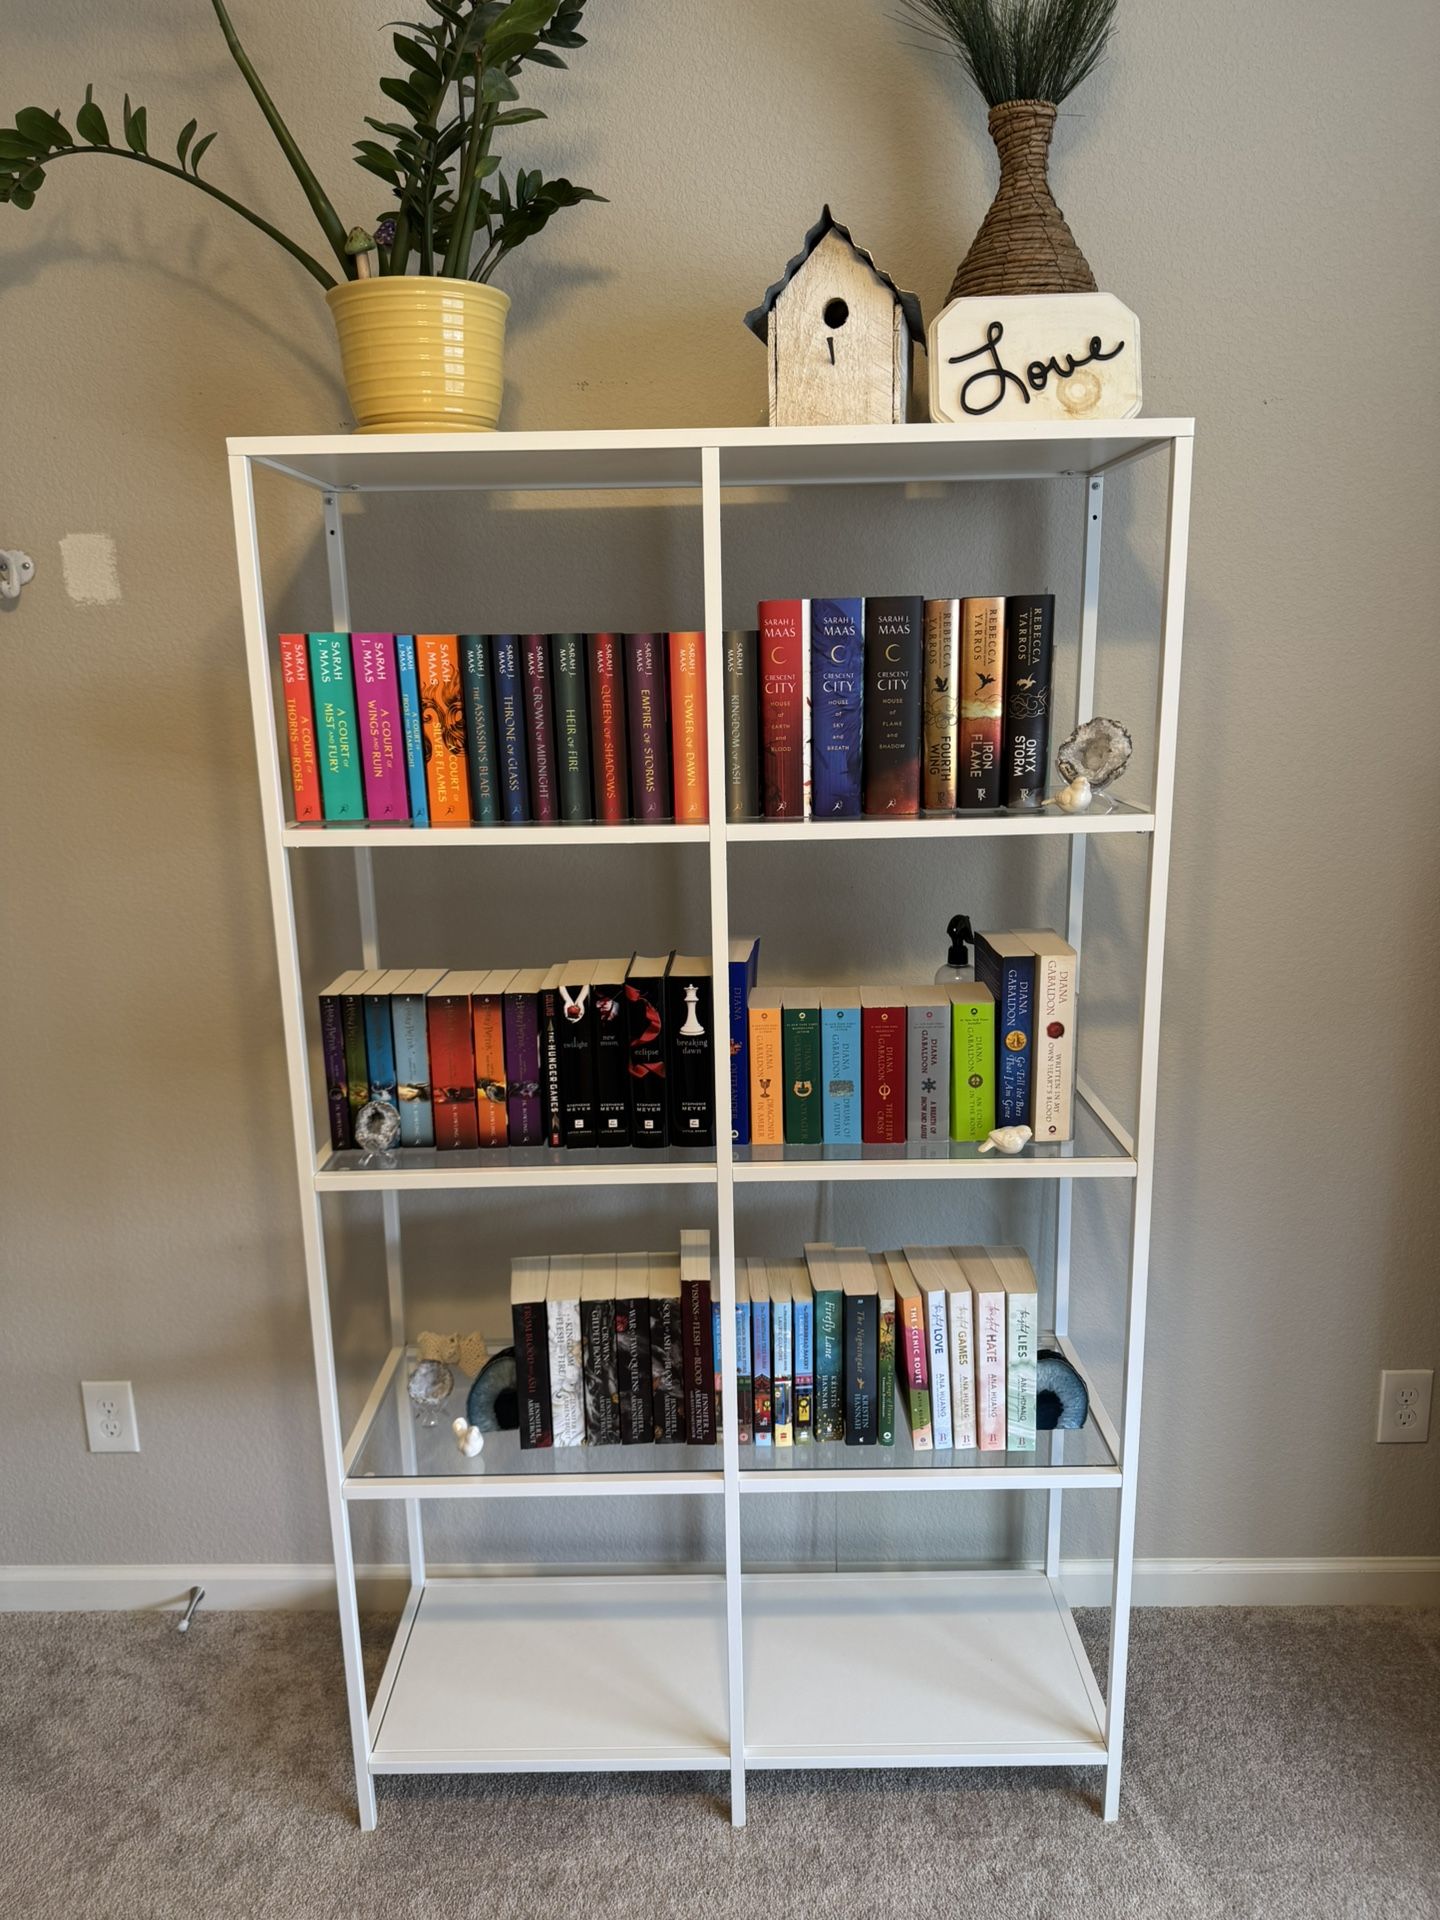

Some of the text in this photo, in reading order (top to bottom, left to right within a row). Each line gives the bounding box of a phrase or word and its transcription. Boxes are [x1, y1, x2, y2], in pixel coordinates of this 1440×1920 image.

[949, 321, 1124, 415] Love
[764, 618, 788, 626] SARAH
[764, 628, 796, 637] MAAS
[824, 626, 855, 636] MAAS
[878, 625, 910, 634] MAAS
[974, 614, 982, 661] YARROS
[988, 609, 997, 665] REBECCA
[1018, 613, 1027, 660] YARROS
[1033, 608, 1042, 664] REBECCA
[406, 645, 414, 670] SARAH
[476, 644, 484, 671] SARAH
[568, 643, 576, 671] SARAH
[605, 644, 613, 671] SARAH
[688, 642, 696, 670] SARAH
[929, 619, 937, 664] YARROS
[943, 613, 951, 668] REBECCA
[285, 652, 294, 683] MAAS
[295, 644, 305, 681] SARAH
[320, 650, 331, 683] MAAS
[332, 642, 343, 680] SARAH
[363, 650, 374, 683] MAAS
[375, 642, 386, 680] SARAH
[428, 652, 438, 685] MAAS
[440, 644, 451, 683] SARAH
[536, 646, 544, 674] SARAH
[765, 683, 797, 694] CITY
[823, 681, 854, 692] CITY
[877, 680, 909, 691] CITY
[287, 699, 303, 792] THORNS ROSES
[302, 727, 313, 764] COURT
[324, 703, 339, 773] MIST FURY
[338, 720, 350, 758] COURT
[368, 700, 383, 778] WINGS RUIN
[382, 720, 393, 758] COURT
[474, 703, 489, 798] ASSASSIN'S BLADE
[504, 696, 519, 791] THRONE GLASS
[533, 686, 549, 799] CROWN MIDNIGHT
[566, 709, 579, 772] HEIR FIRE
[601, 684, 616, 799] QUEEN SHADOWS
[641, 689, 655, 792] EMPIRE STORMS
[684, 694, 696, 787] TOWER DAWN
[731, 695, 741, 785] KINGDOM ASH
[970, 734, 982, 778] FLAME
[982, 742, 993, 769] IRON
[1026, 739, 1037, 772] ONYX
[432, 722, 447, 802] SILVER FLAMES
[449, 755, 459, 791] COURT
[930, 745, 940, 775] WING
[941, 736, 951, 781] FOURTH
[1014, 736, 1025, 777] STORM
[1007, 970, 1017, 1026] GABALDON
[1019, 981, 1028, 1015] DIANA
[1046, 961, 1057, 1016] GABALDON
[1059, 971, 1068, 1003] DIANA
[564, 1037, 588, 1049] twilight
[635, 1049, 658, 1061] eclipse
[676, 1039, 708, 1048] breaking
[548, 1045, 557, 1082] HUNGER
[1017, 1070, 1025, 1086] Tell
[1054, 1053, 1062, 1089] WRITTEN
[550, 1084, 558, 1113] GAMES
[1005, 1081, 1012, 1097] Am
[843, 1099, 851, 1126] DRUMS
[1002, 1100, 1013, 1118] Gone
[565, 1322, 574, 1366] KINGDOM
[601, 1326, 610, 1361] CROWN
[691, 1284, 702, 1384] VISIONS BLOOD
[822, 1301, 835, 1359] Firefly Lane
[855, 1311, 865, 1372] The Nightingale
[912, 1326, 921, 1354] SCENIC
[934, 1328, 943, 1354] LOVE
[958, 1331, 968, 1365] GAMES
[986, 1334, 997, 1362] HATE
[1018, 1335, 1027, 1358] LIES
[914, 1357, 922, 1384] ROUTE
[695, 1389, 703, 1439] ARMENTROUT
